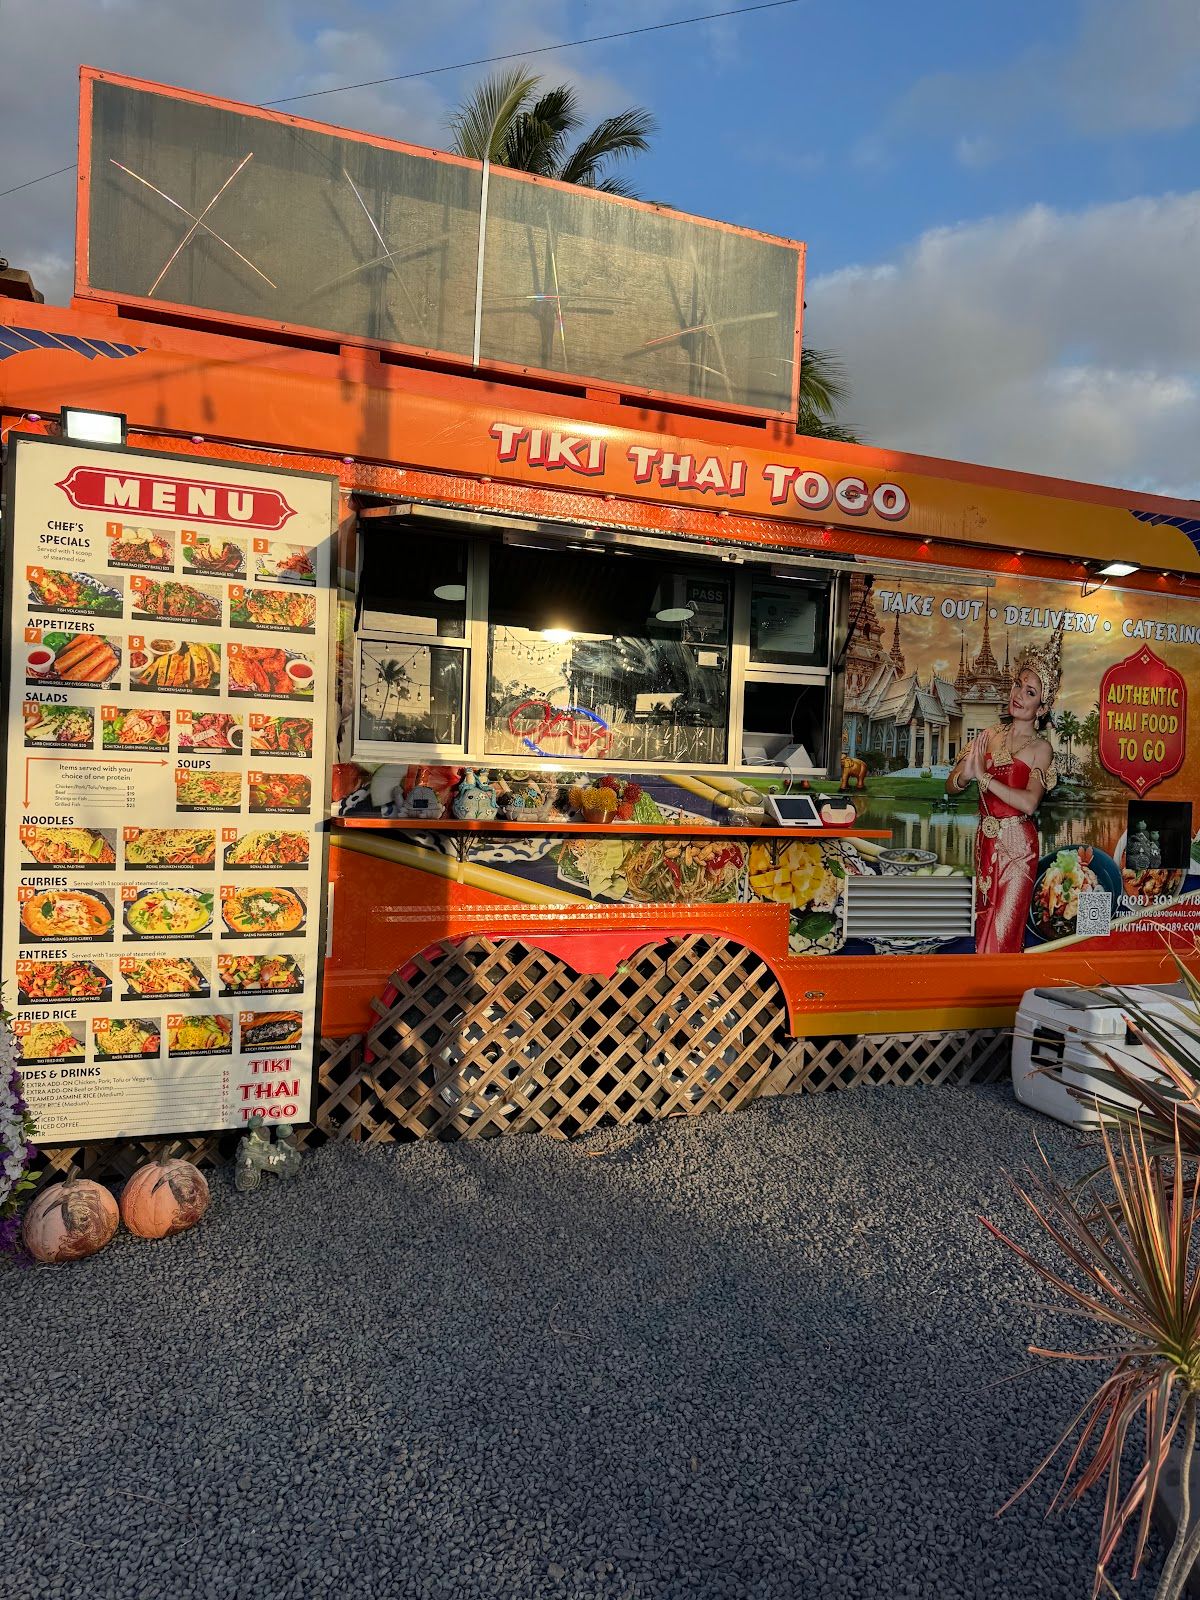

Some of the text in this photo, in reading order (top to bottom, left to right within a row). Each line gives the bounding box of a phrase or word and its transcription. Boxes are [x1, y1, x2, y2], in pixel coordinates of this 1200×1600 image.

[489, 422, 910, 521] TIKI THAI TOGO
[103, 476, 254, 520] MENU
[48, 520, 84, 532] CHEF'S
[112, 525, 117, 534] 1
[40, 535, 90, 547] SPECIALS
[186, 533, 192, 542] 2
[258, 541, 264, 550] 3
[31, 569, 39, 578] 4
[134, 578, 141, 587] 5
[232, 587, 239, 596] 6
[692, 588, 724, 601] PASS
[880, 591, 935, 616] TAKE
[941, 598, 984, 621] OUT
[1004, 605, 1099, 633] DELIVERY
[28, 619, 94, 631] APPETIZERS
[30, 630, 38, 640] 7
[132, 638, 140, 647] 8
[231, 646, 238, 654] 9
[26, 692, 67, 702] SALADS
[1107, 683, 1179, 708] AUTHENTIC
[24, 704, 38, 713] 10
[102, 708, 116, 717] 11
[178, 712, 190, 720] 12
[250, 715, 263, 725] 13
[1107, 710, 1178, 734] THAI FOOD
[1118, 738, 1166, 762] TO GO
[178, 760, 210, 768] SOUPS
[176, 770, 189, 780] 14
[249, 773, 262, 782] 15
[22, 816, 74, 825] NOODLES
[21, 828, 35, 837] 16
[124, 829, 139, 838] 17
[223, 830, 236, 839] 18
[21, 877, 67, 886] CURRIES
[19, 889, 34, 898] 19
[122, 889, 136, 898] 20
[221, 888, 234, 896] 21
[1117, 894, 1149, 906] (808)
[19, 950, 67, 959] ENTREES
[120, 960, 134, 969] 23
[219, 957, 232, 965] 24
[17, 962, 32, 971] 22
[17, 1010, 77, 1020] FRIED RICE
[240, 1014, 253, 1023] 28
[93, 1020, 108, 1029] 26
[168, 1017, 182, 1026] 27
[16, 1023, 30, 1033] 25
[248, 1058, 291, 1074] TIKI
[22, 1068, 100, 1080] IDES & DRINKS
[238, 1080, 300, 1100] THAI
[239, 1104, 298, 1121] TOGO
